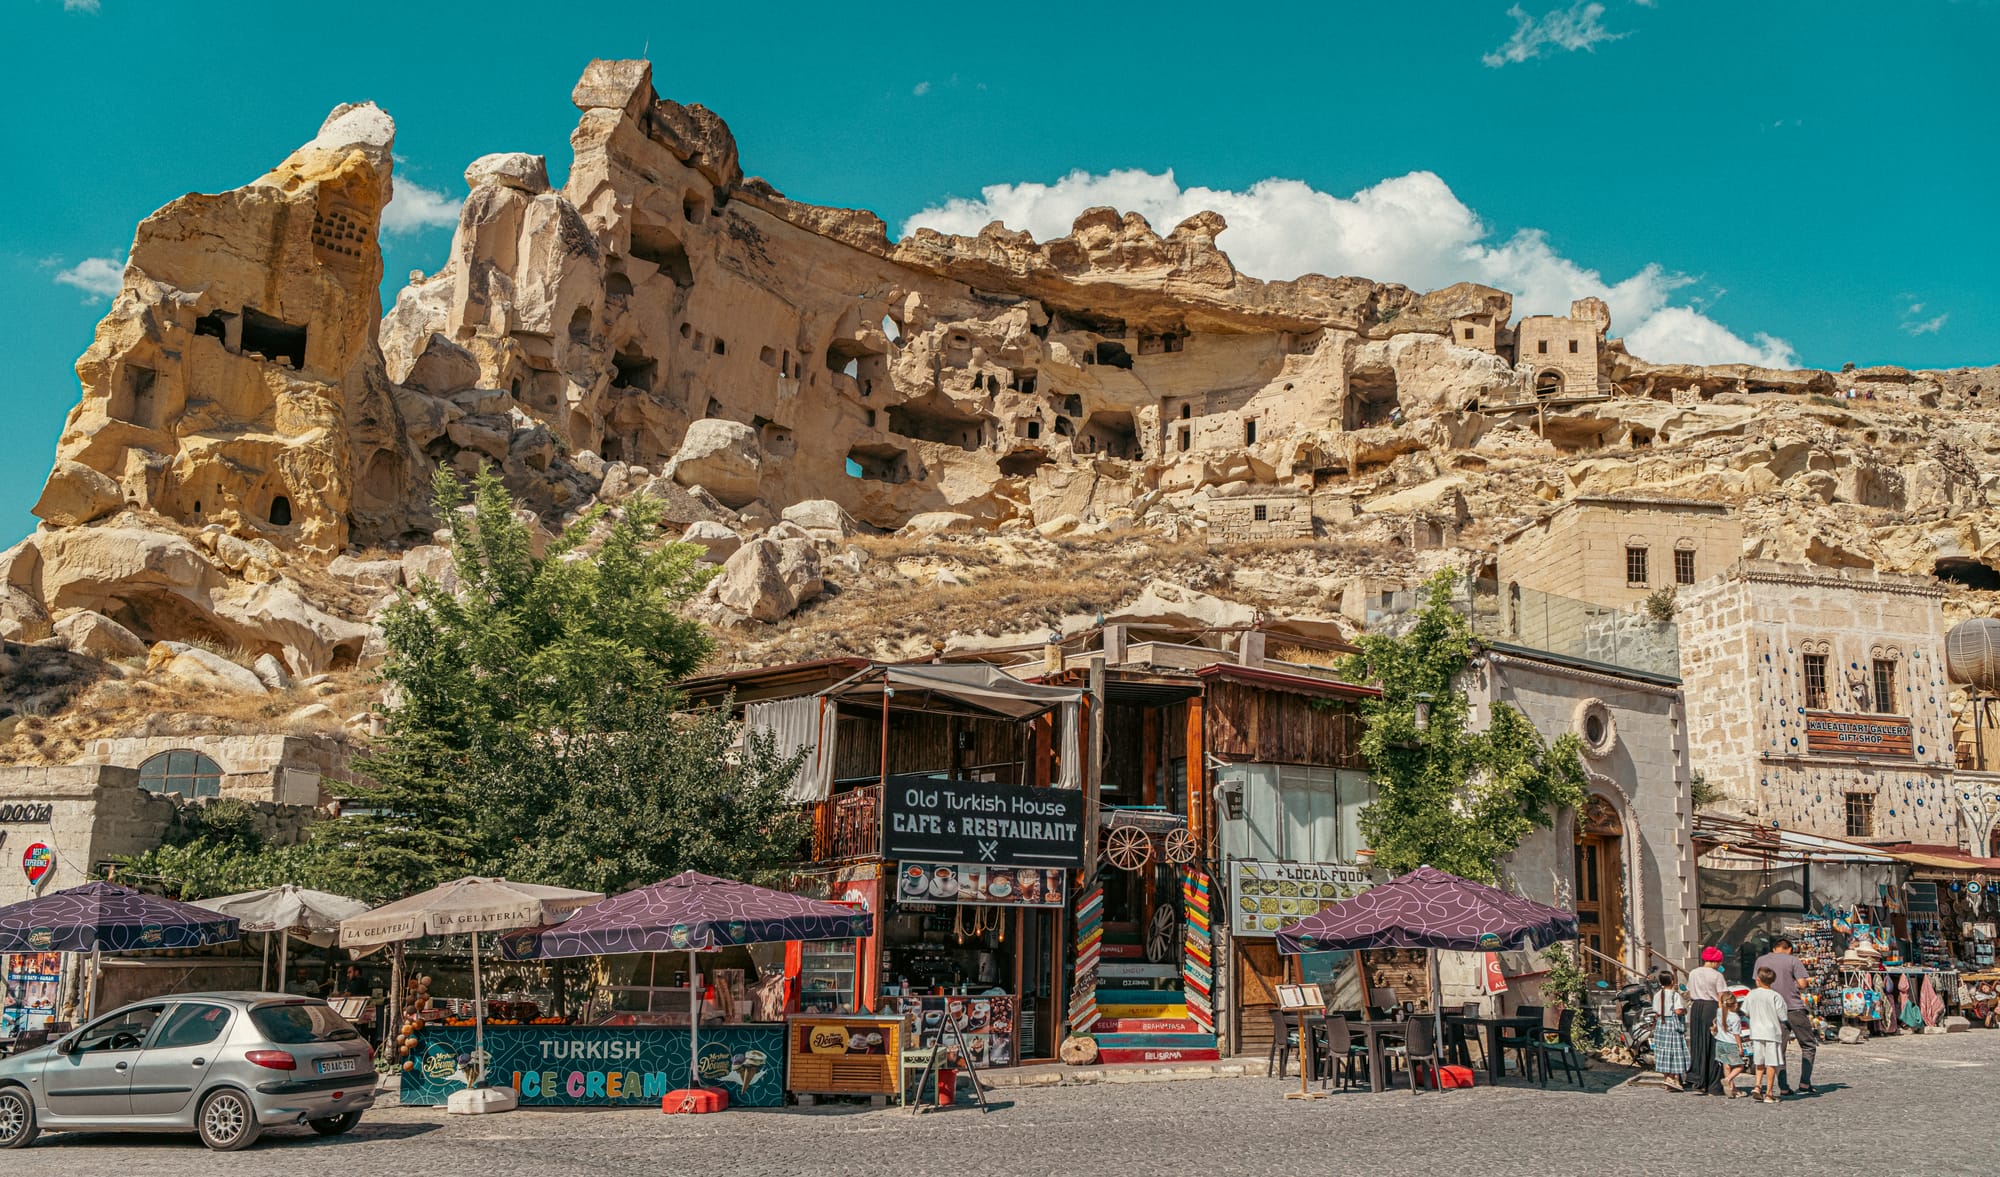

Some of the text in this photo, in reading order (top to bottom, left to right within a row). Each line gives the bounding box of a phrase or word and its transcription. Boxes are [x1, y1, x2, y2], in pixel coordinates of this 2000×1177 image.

[1810, 721, 1908, 736] KALEALTI ART GALLERY
[1838, 734, 1882, 743] GIFT SHOP
[906, 789, 1066, 816] Old Turkish House
[893, 812, 1077, 842] CAFE & RESTAURANT
[1287, 867, 1364, 882] LOCAL FOOD
[439, 912, 524, 925] LA GELATERIA
[347, 923, 409, 939] LA GELATERIA
[539, 1040, 641, 1059] TURKISH
[511, 1070, 667, 1099] ICE CREAM
